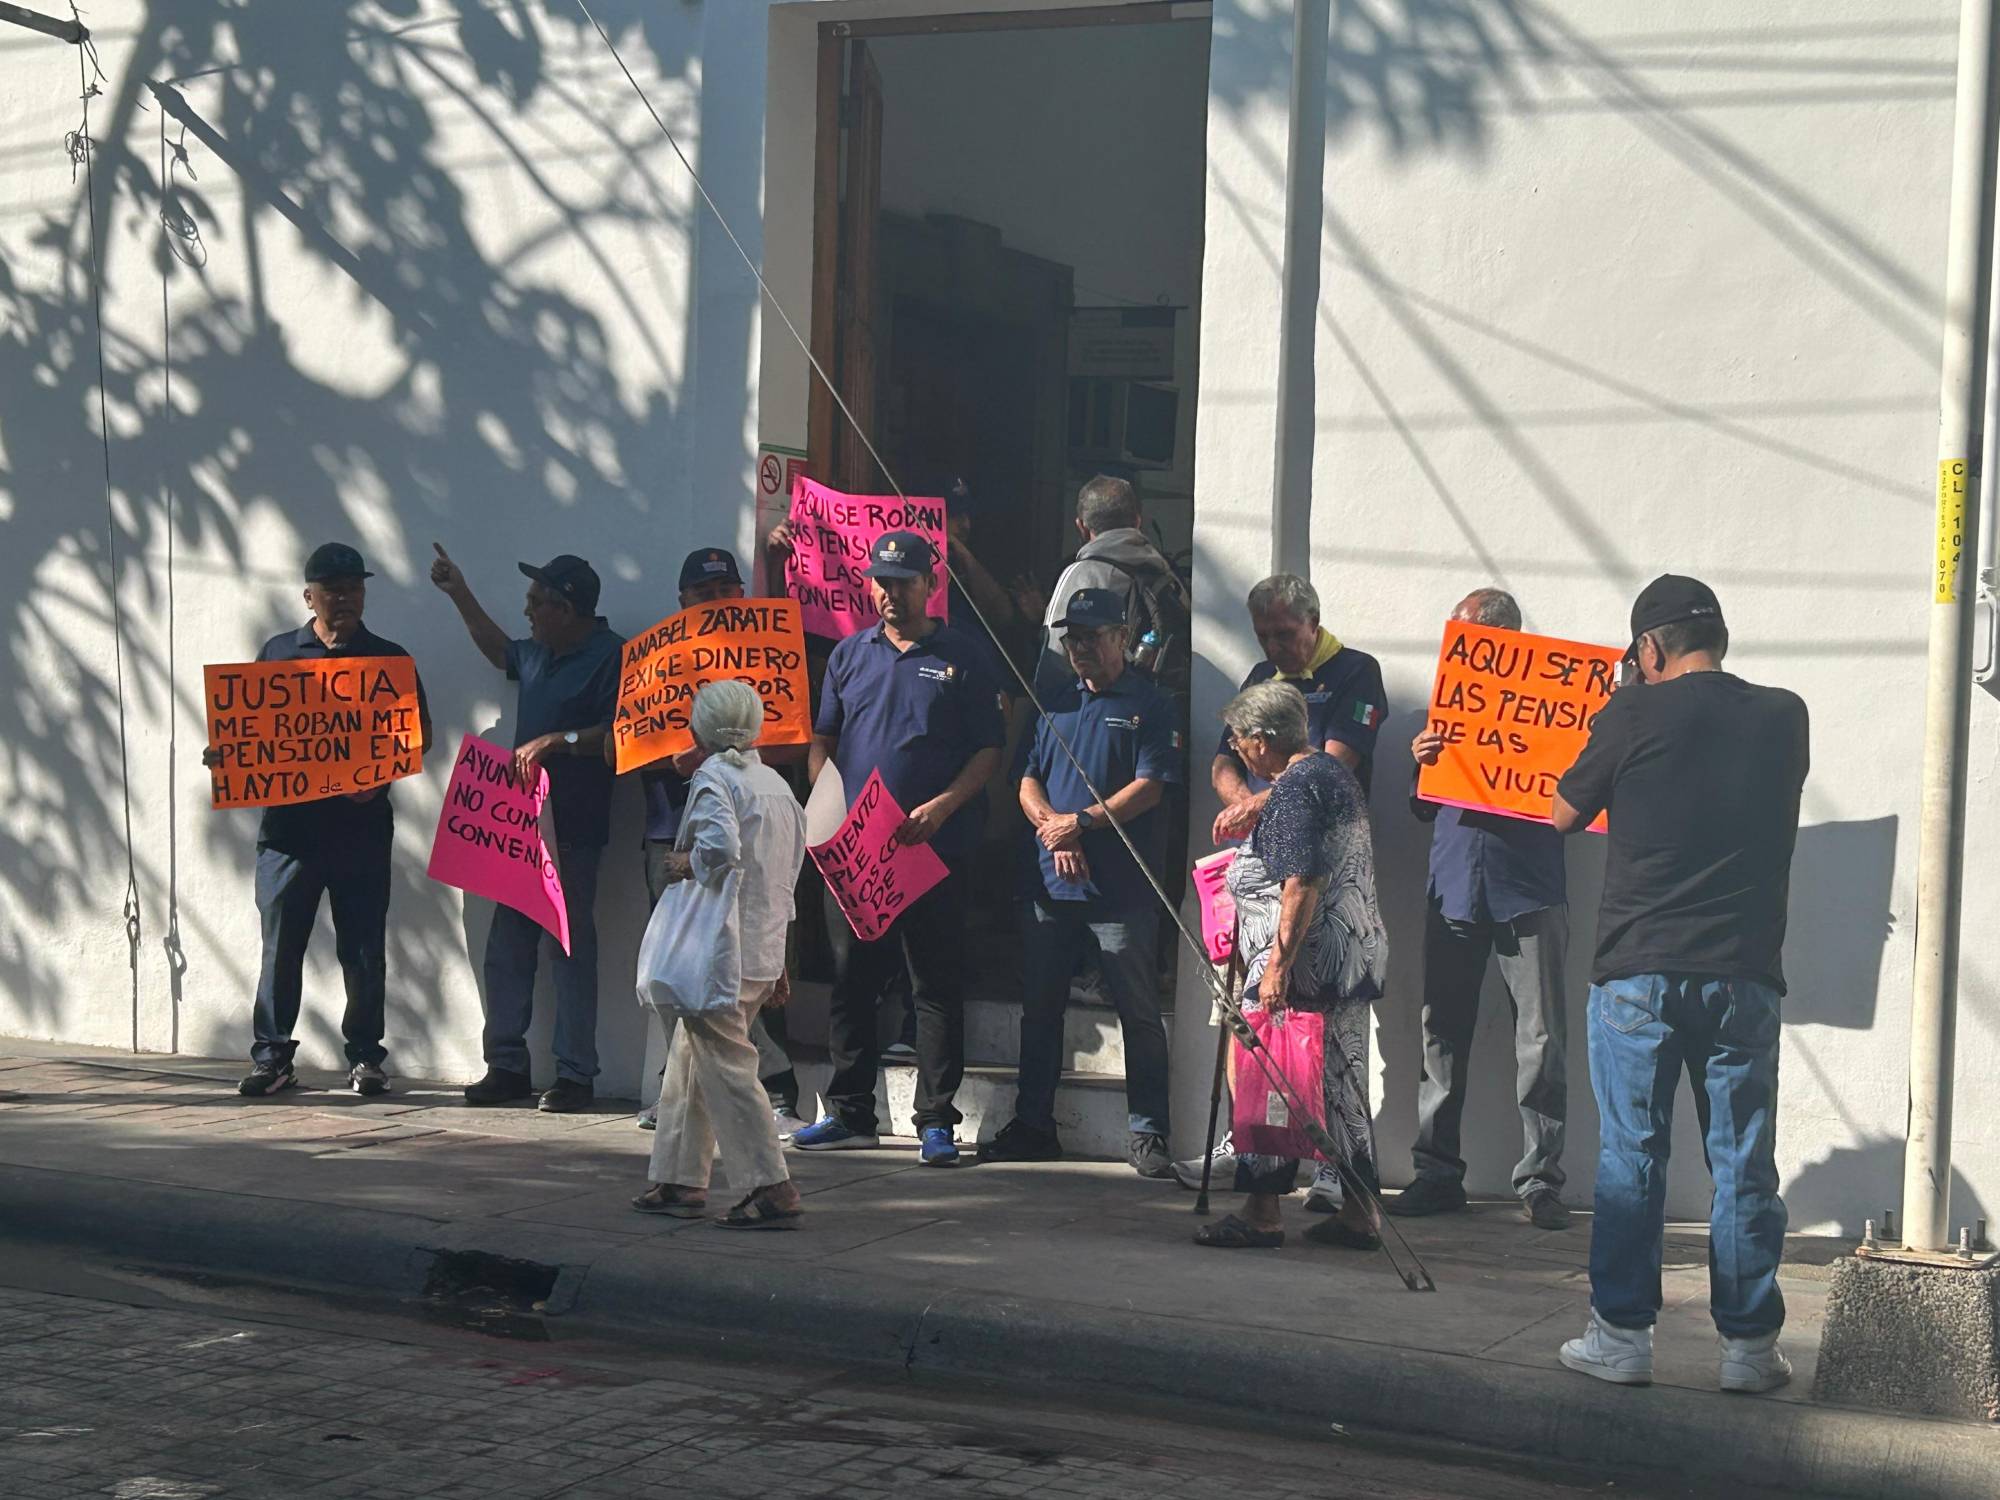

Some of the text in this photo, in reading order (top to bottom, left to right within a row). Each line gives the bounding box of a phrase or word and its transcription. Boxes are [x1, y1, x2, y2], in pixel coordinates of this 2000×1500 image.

[834, 503, 860, 527] SE
[864, 504, 943, 531] ROBAN
[823, 559, 864, 588] LAS
[787, 582, 881, 616] CONVENI
[625, 606, 791, 668] ANABEL ZARATE
[621, 647, 801, 697] EXIGE DINERO
[1445, 633, 1534, 681] AQUI
[1540, 652, 1583, 686] SE
[214, 669, 399, 711] JUSTICIA
[1435, 674, 1486, 713] LAS
[216, 708, 412, 739] ME ROBAN MI
[616, 705, 630, 723] A
[219, 734, 410, 769] PENSION EN
[1432, 719, 1528, 754] DE LAS
[453, 782, 484, 812] NO
[816, 780, 880, 865] MIENTO
